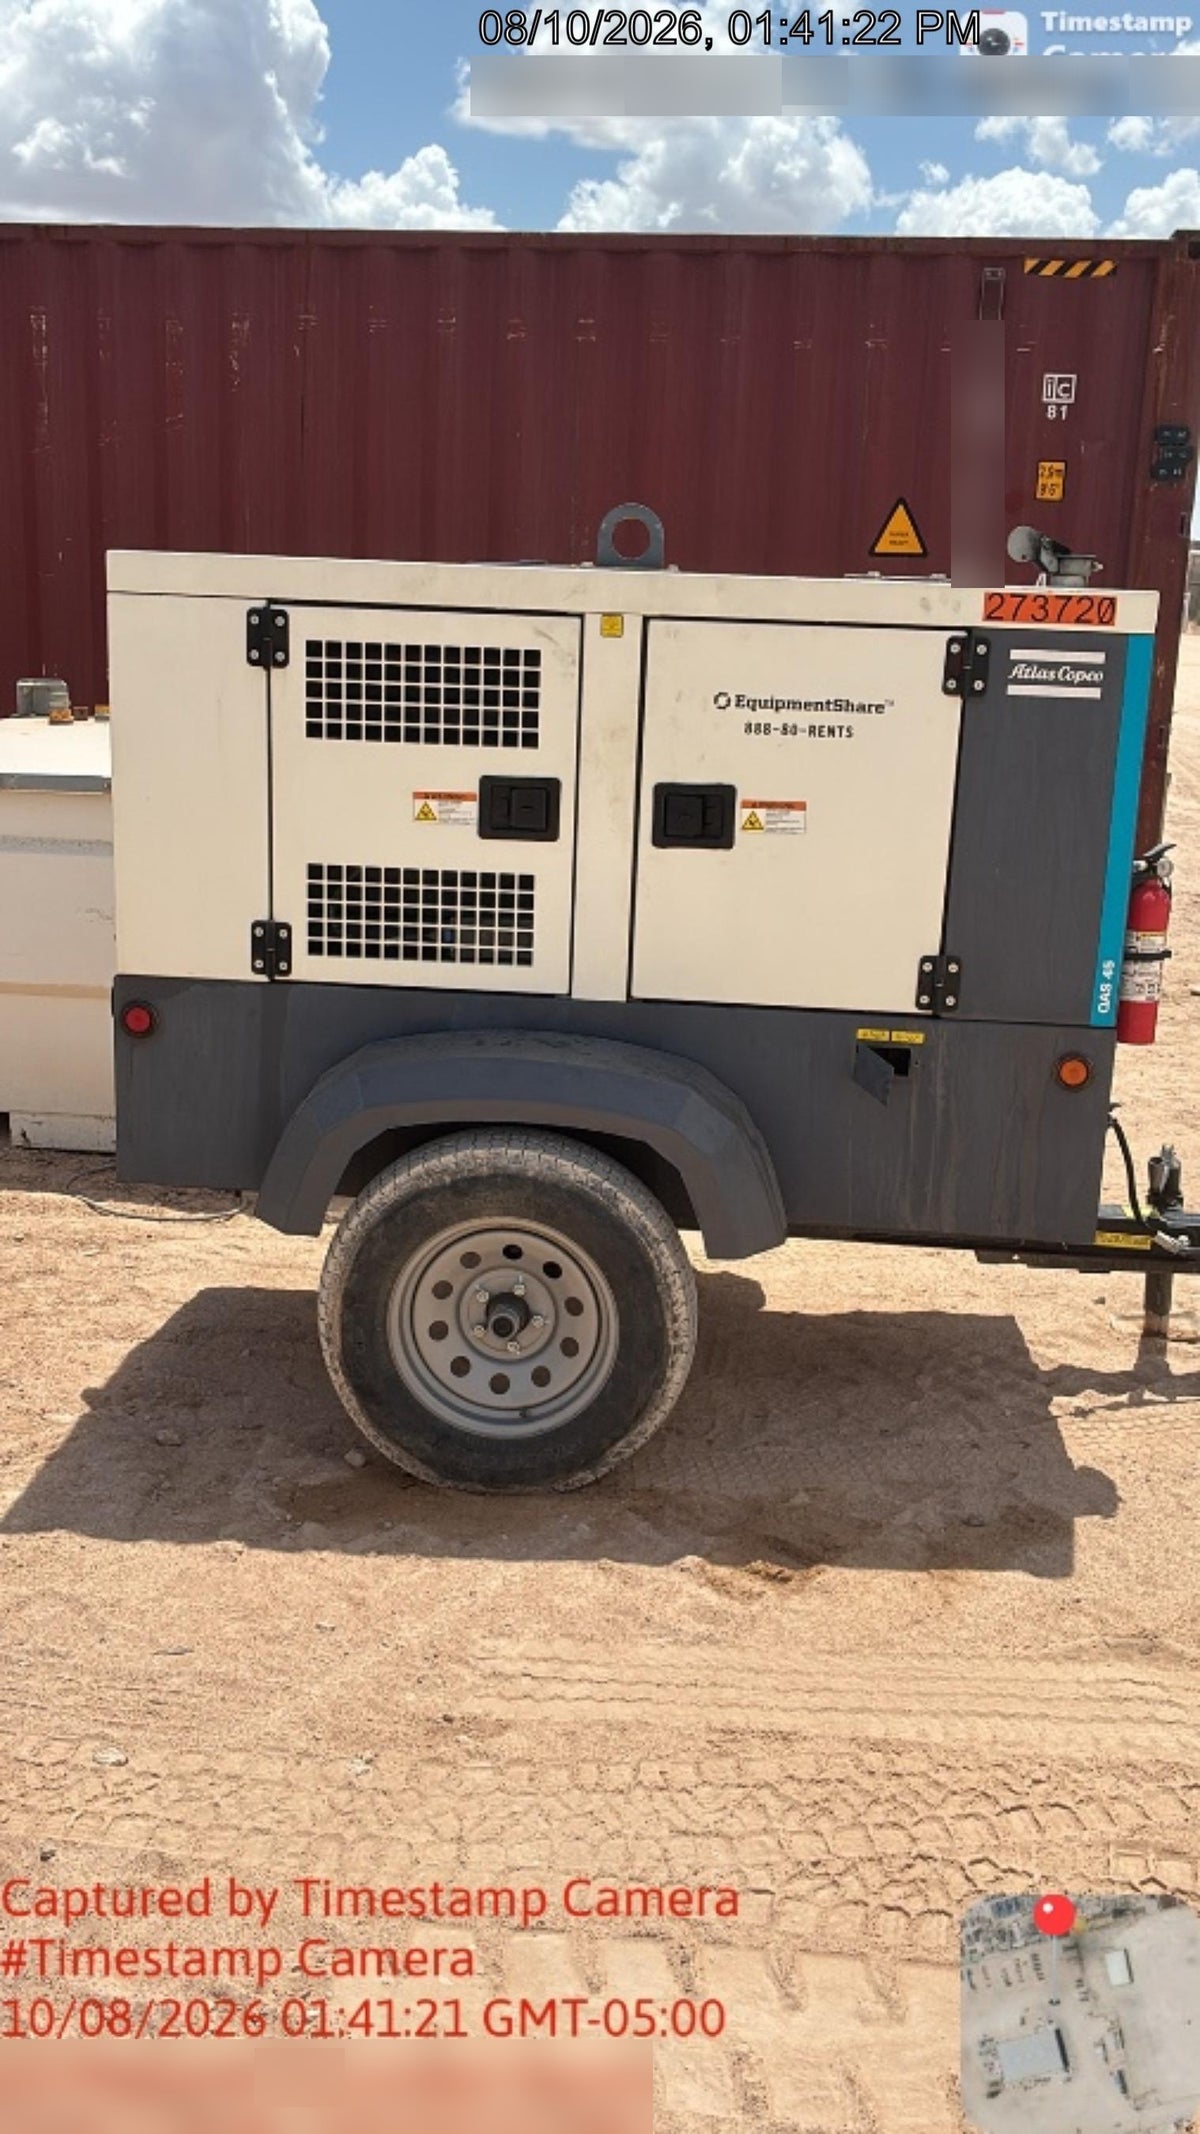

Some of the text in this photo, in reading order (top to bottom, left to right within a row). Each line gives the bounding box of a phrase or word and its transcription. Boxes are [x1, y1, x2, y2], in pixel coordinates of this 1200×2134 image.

[1047, 404, 1068, 420] 81
[985, 592, 1117, 625] 273720
[1008, 663, 1104, 685] Atlas Copco
[744, 722, 855, 739] 888-80-RENTS
[1097, 983, 1113, 1014] QAS
